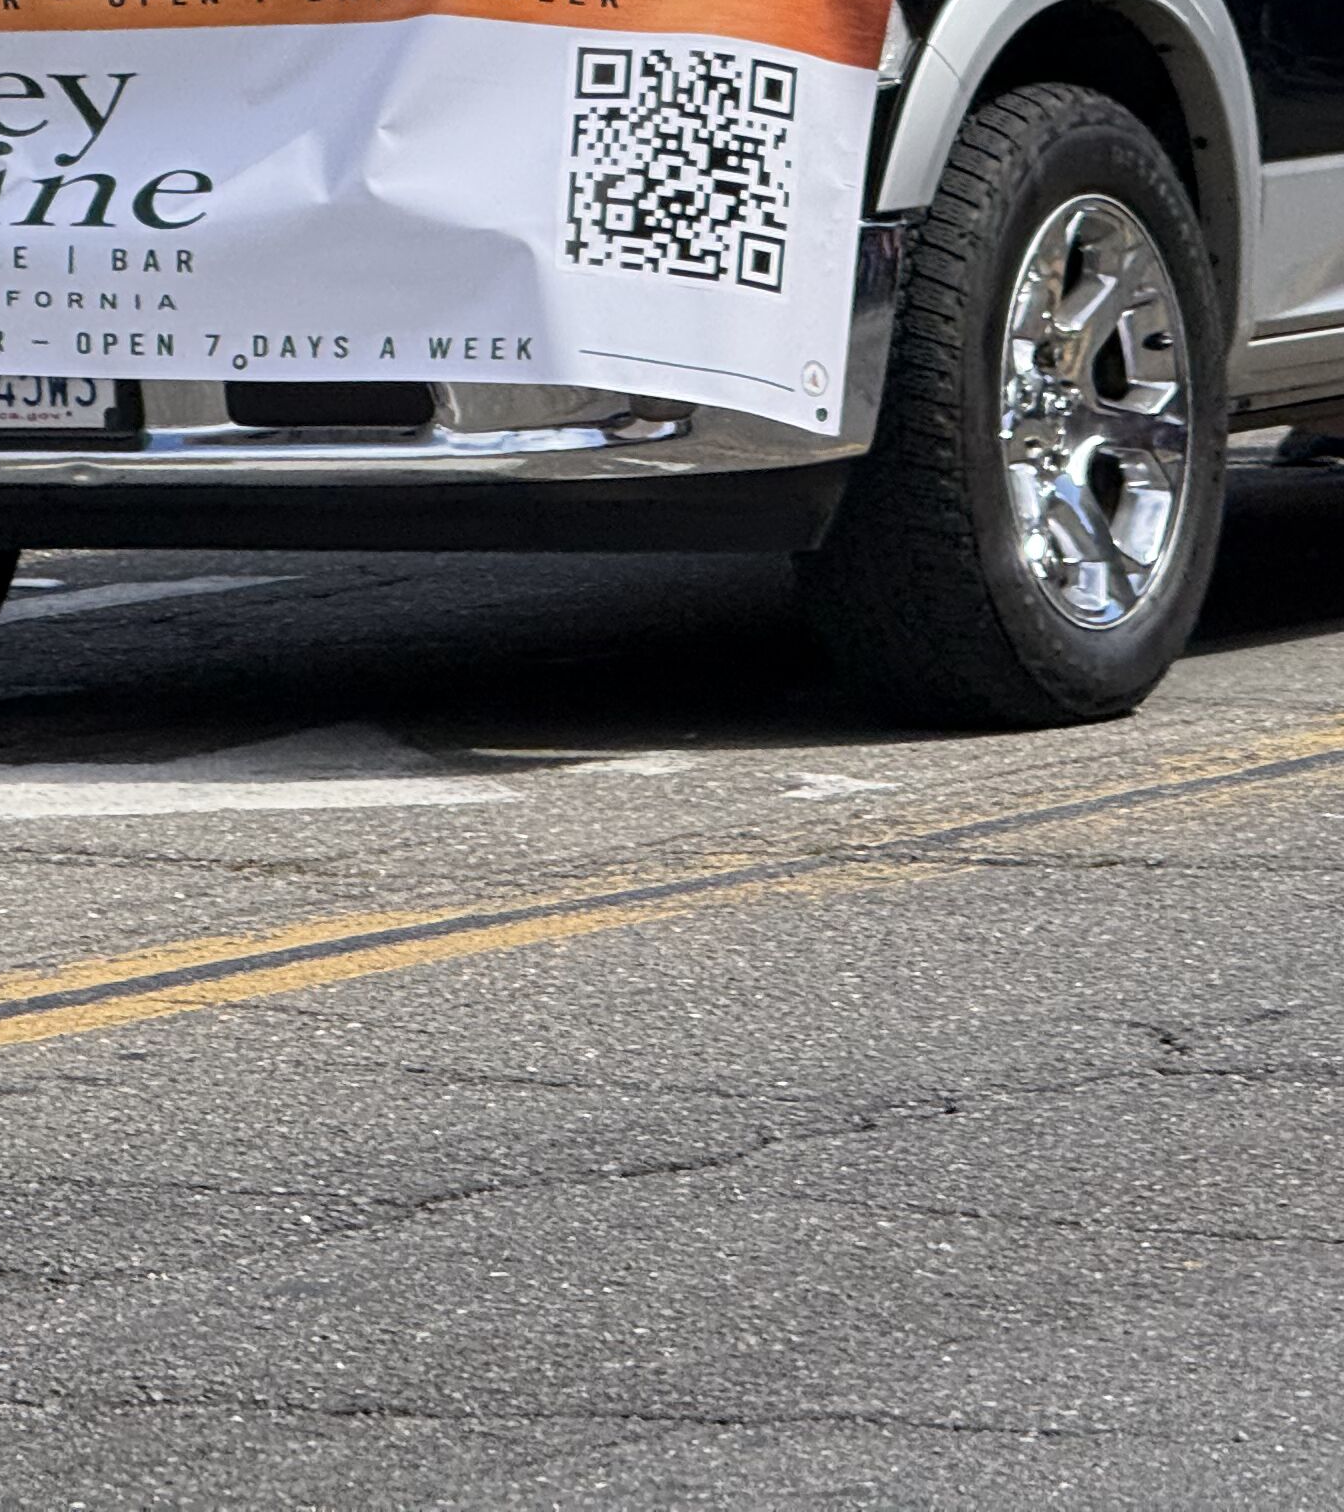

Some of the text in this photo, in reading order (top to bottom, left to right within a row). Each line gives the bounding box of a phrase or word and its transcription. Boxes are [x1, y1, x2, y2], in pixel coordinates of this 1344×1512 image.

[111, 247, 196, 274] BAR
[76, 331, 175, 358] OPEN
[205, 334, 222, 358] 7
[252, 334, 350, 359] DAYS
[378, 335, 397, 360] A
[427, 336, 534, 361] WEEK
